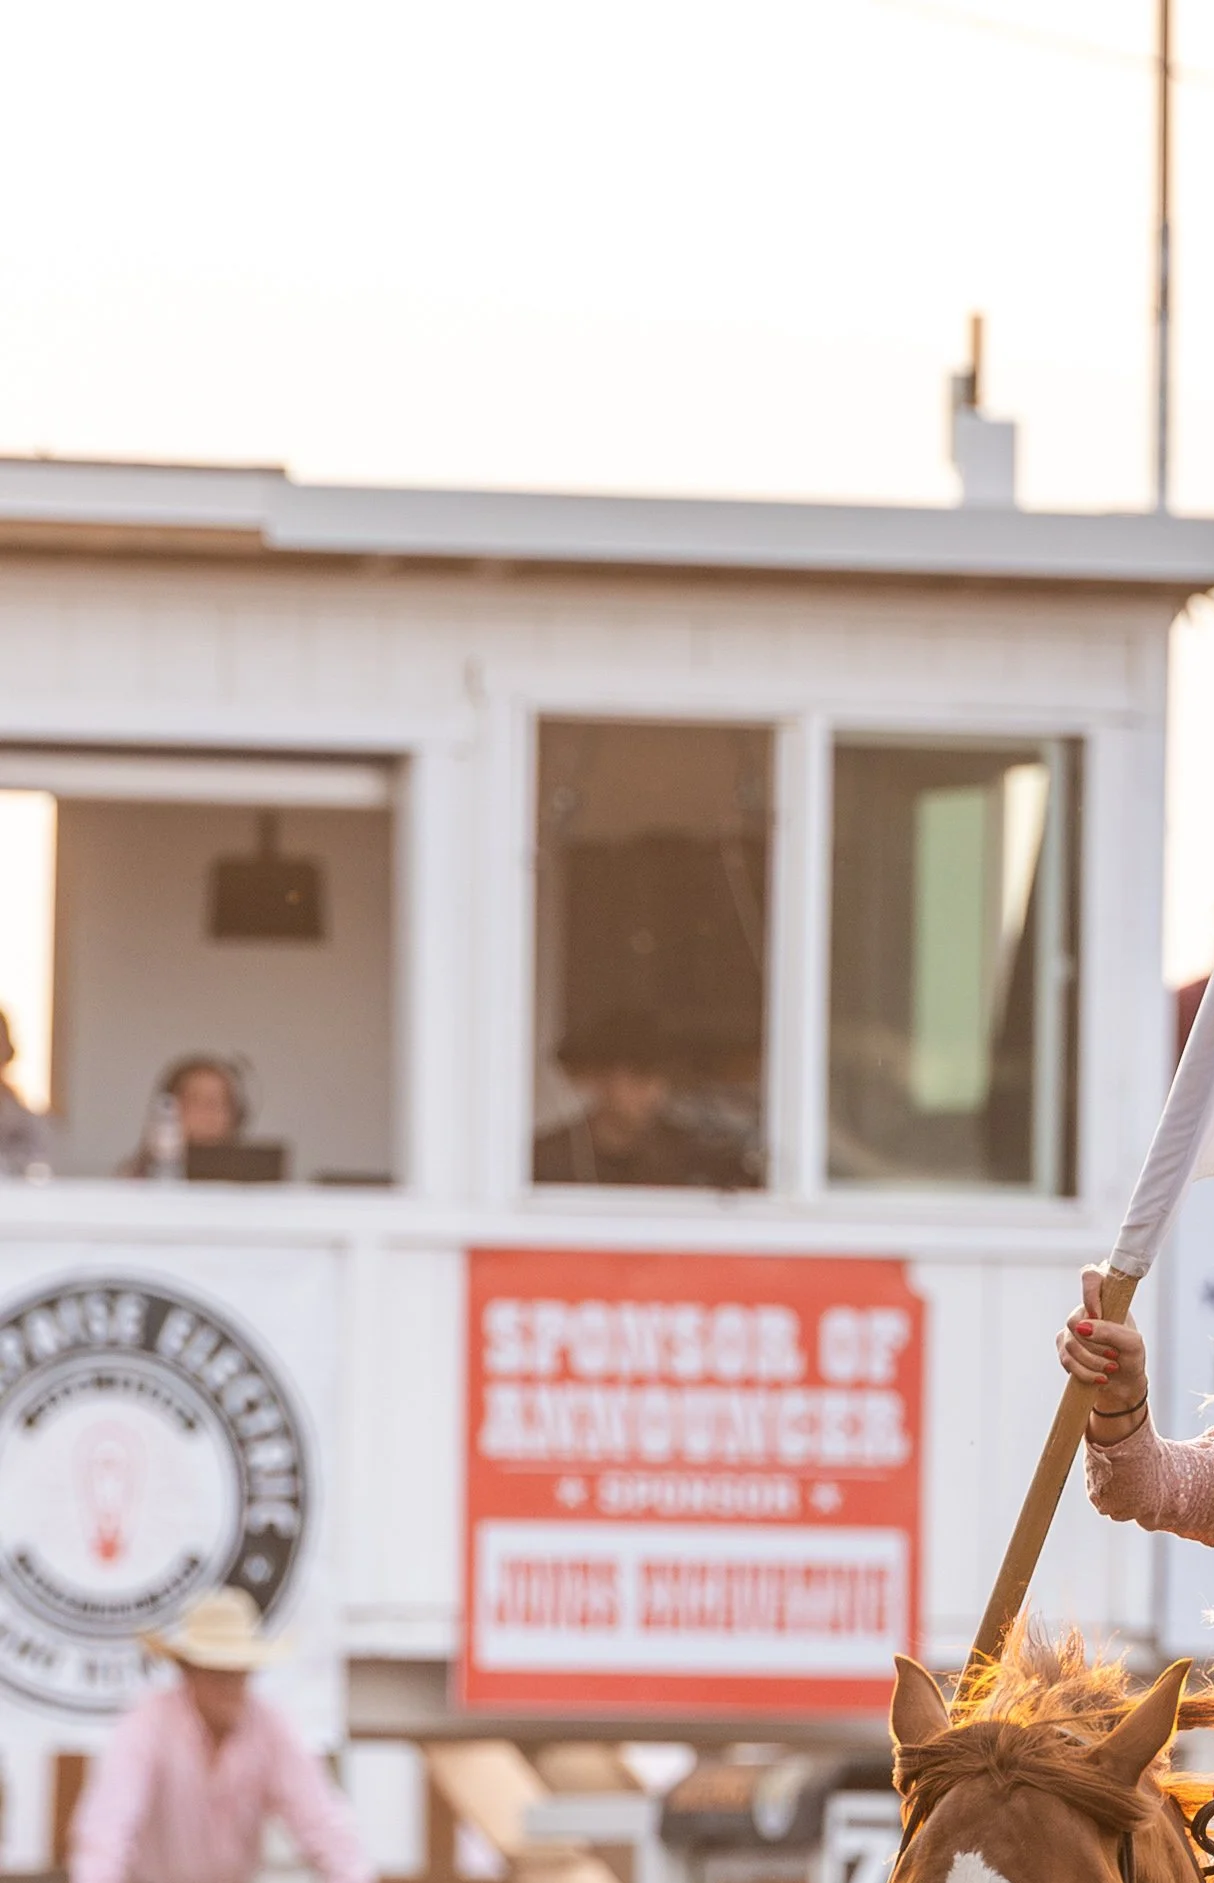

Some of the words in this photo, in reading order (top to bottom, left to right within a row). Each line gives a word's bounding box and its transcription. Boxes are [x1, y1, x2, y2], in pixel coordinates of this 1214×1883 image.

[482, 1298, 806, 1379] SPONSOR
[818, 1305, 912, 1384] OF
[155, 1304, 300, 1540] ELECTRIC
[479, 1381, 912, 1467] ANNOUNCER
